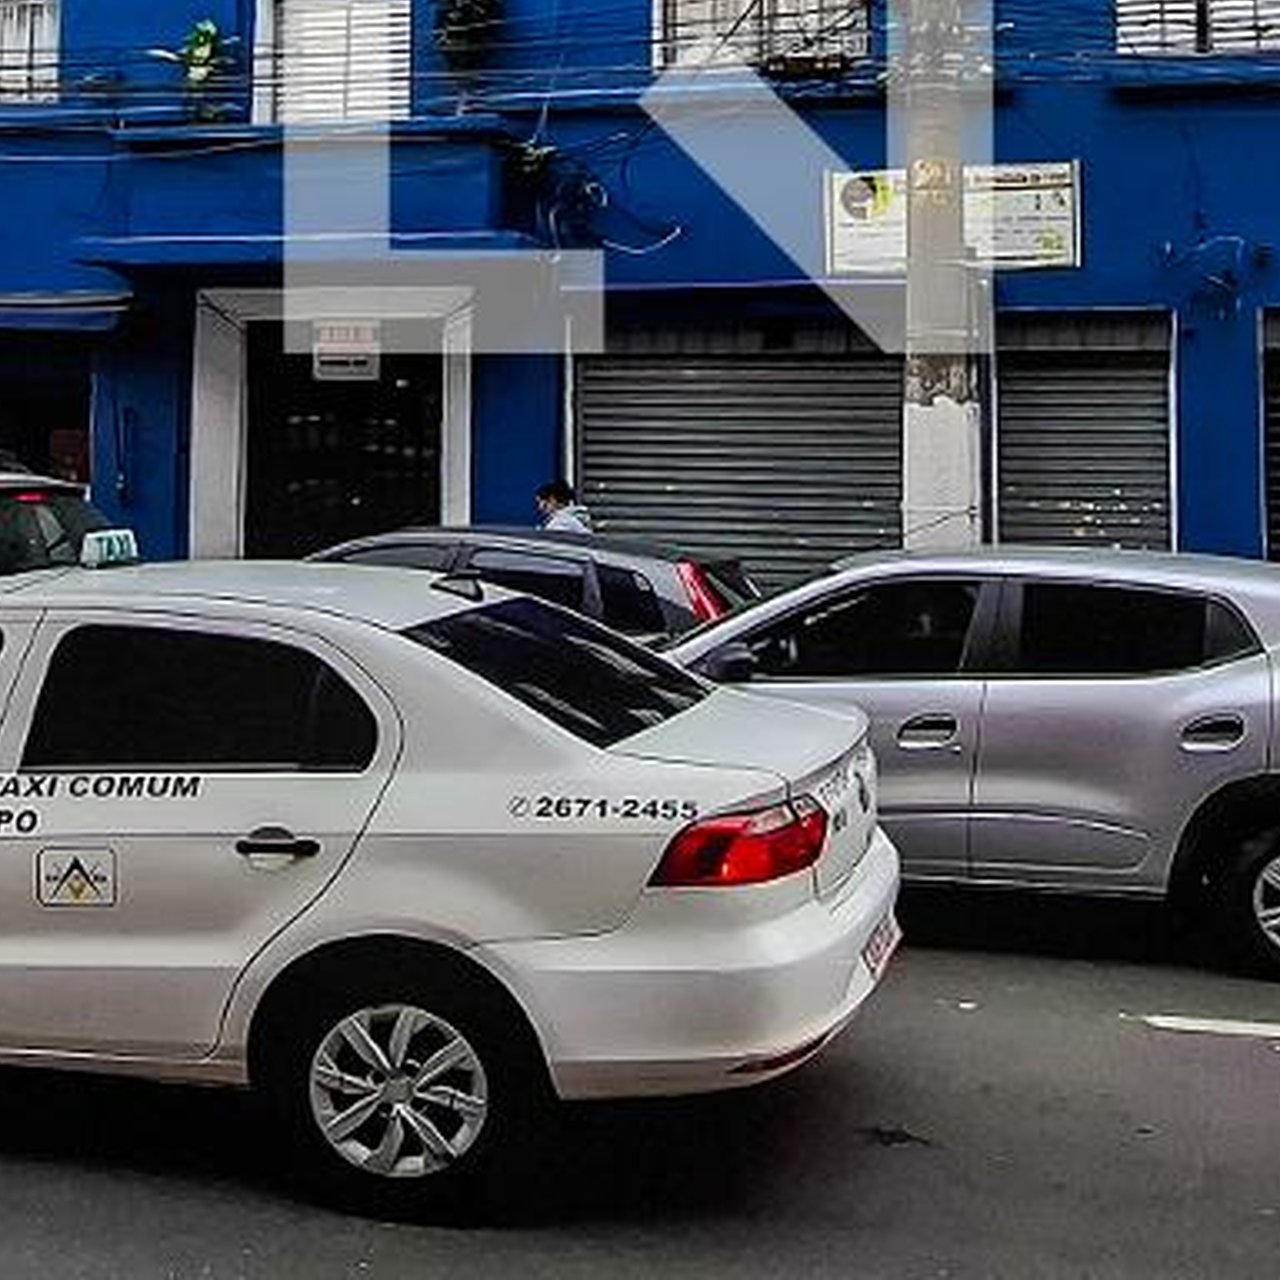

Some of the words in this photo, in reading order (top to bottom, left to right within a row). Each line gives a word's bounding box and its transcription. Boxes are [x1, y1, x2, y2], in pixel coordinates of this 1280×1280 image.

[96, 533, 132, 559] TAXI
[69, 776, 202, 798] COMUM
[535, 796, 699, 820] 2671-2455
